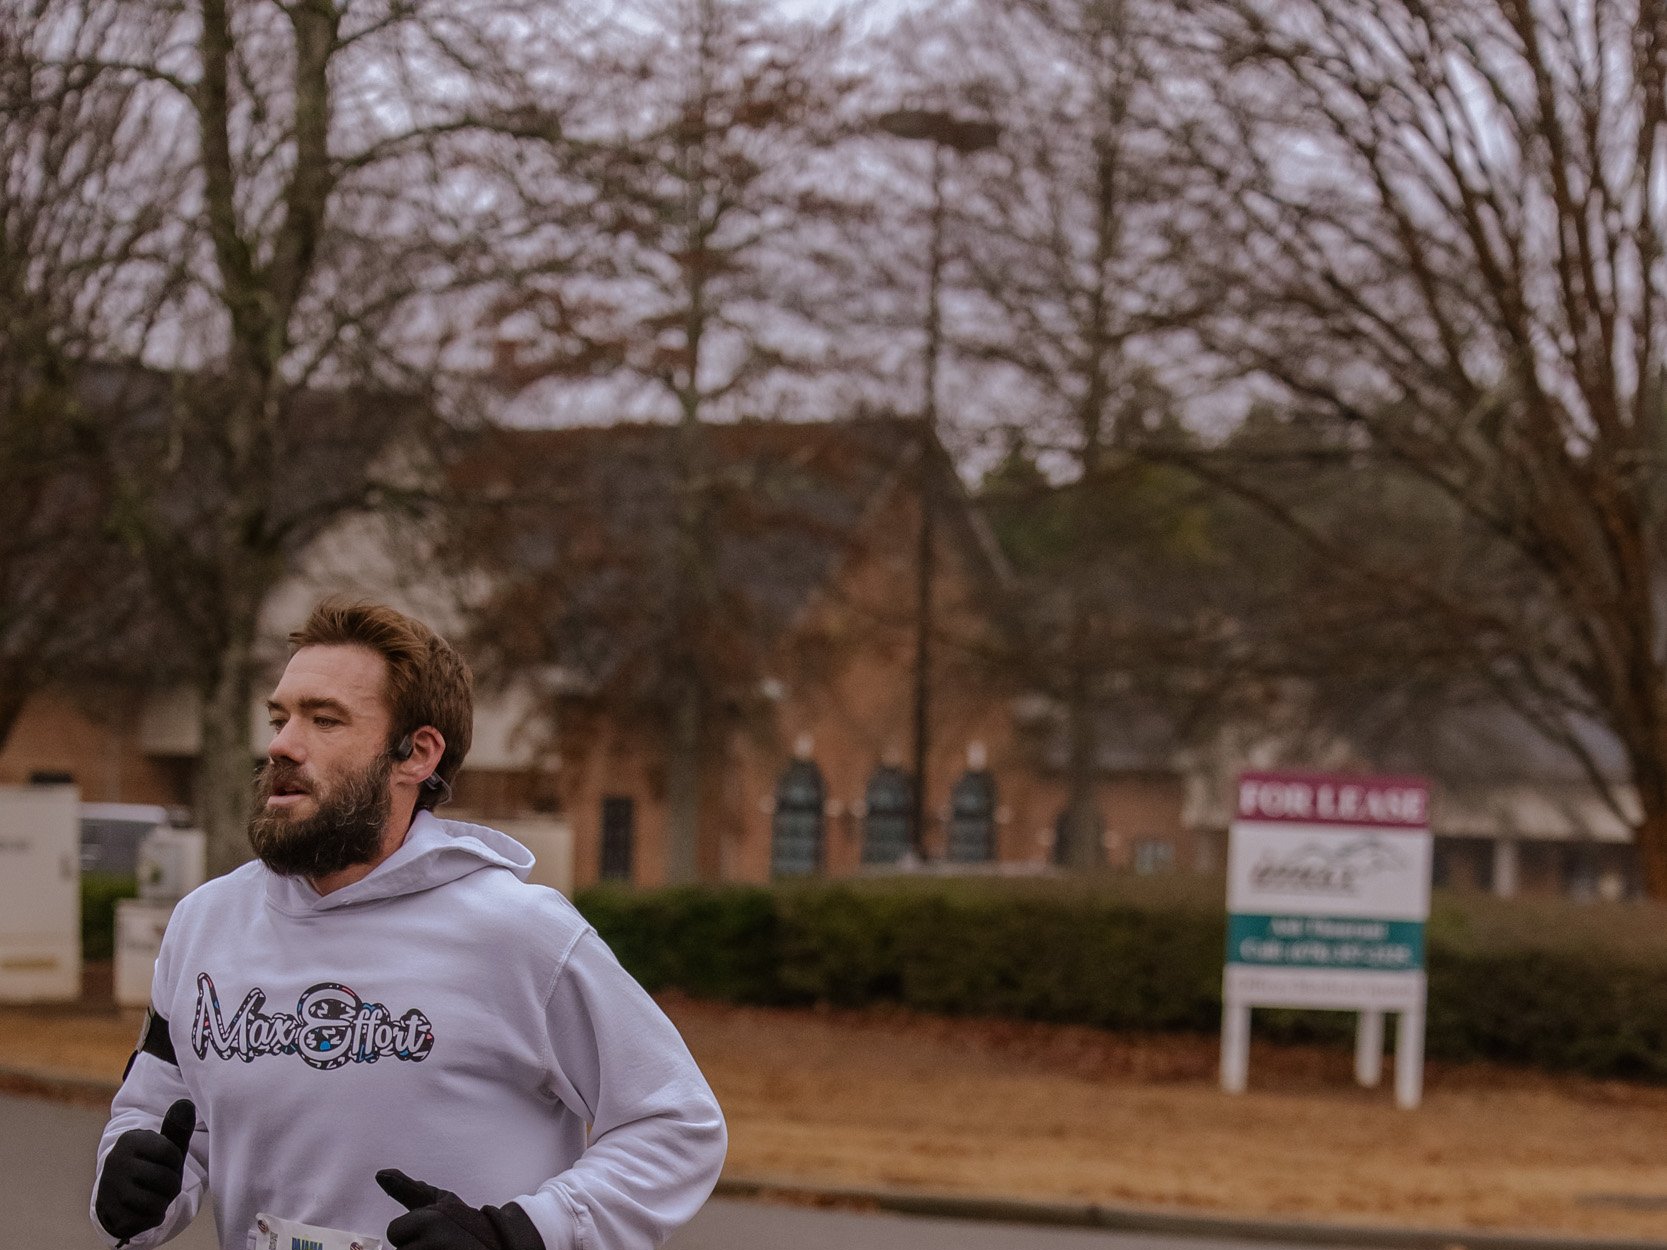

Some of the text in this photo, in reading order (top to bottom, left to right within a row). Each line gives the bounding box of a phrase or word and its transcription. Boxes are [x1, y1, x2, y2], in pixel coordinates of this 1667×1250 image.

[1239, 781, 1425, 823] FOR LEASE
[191, 972, 435, 1070] Max Effort
